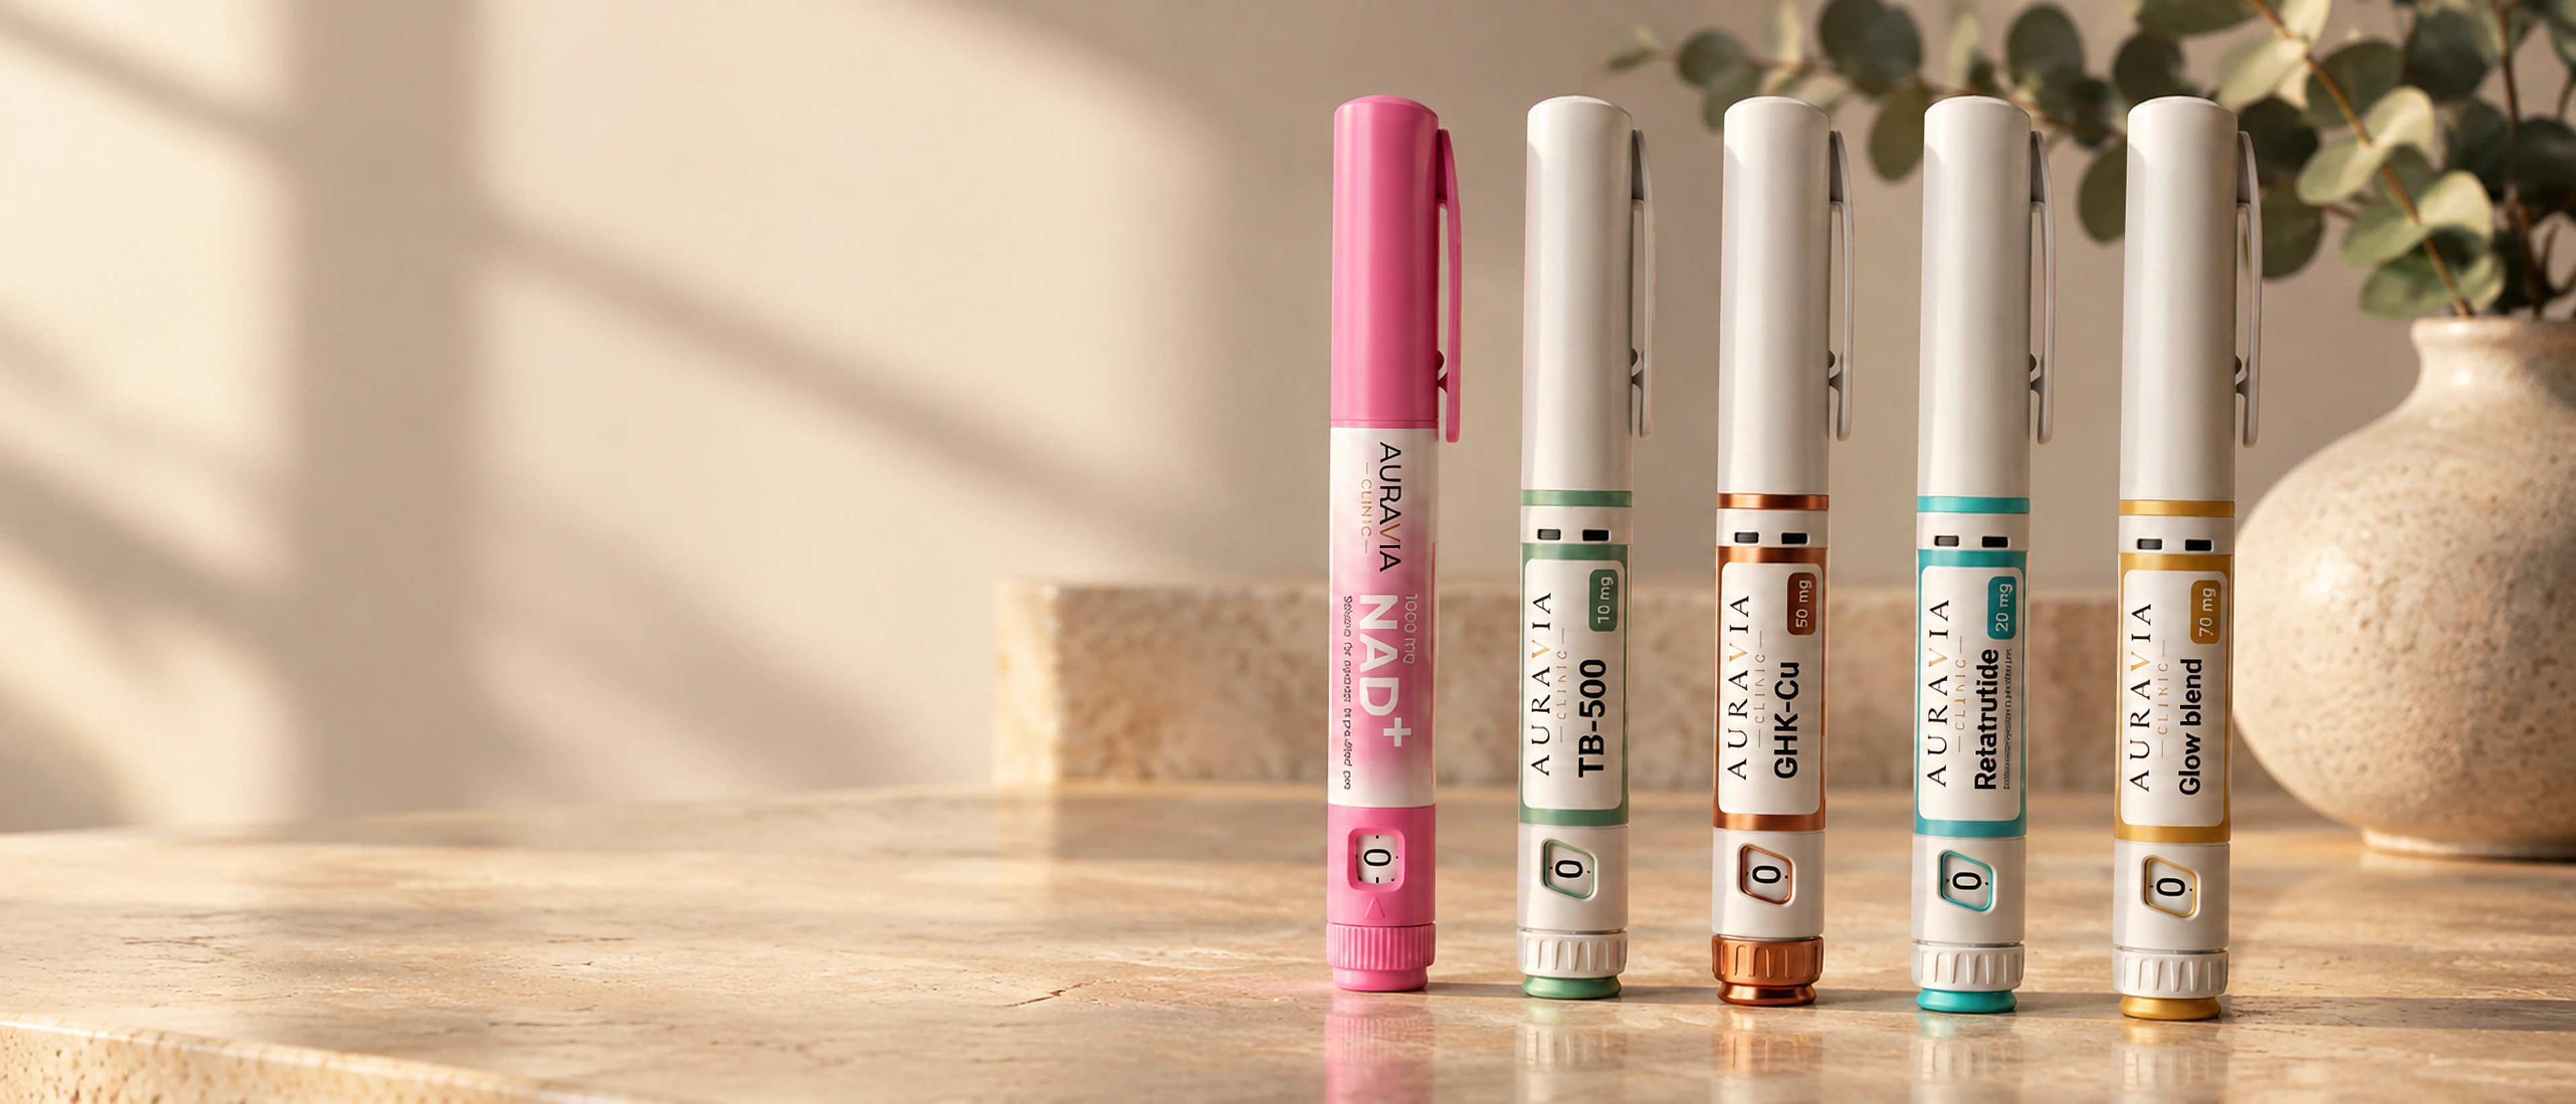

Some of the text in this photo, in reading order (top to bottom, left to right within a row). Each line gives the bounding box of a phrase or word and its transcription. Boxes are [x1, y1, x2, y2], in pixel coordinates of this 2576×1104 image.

[1361, 479, 1373, 537] CLINIC
[1379, 442, 1402, 572] AURAVIA
[1405, 594, 1418, 633] 1000
[1597, 576, 1613, 624] 10 mg
[1796, 580, 1812, 628] 50 mg
[1995, 613, 2009, 632] 20
[1999, 583, 2013, 608] mg
[2199, 587, 2216, 637] 70 mg
[1531, 592, 1552, 777] AURAVIA
[1727, 595, 1749, 781] AURAVIA
[1927, 600, 1949, 788] AURAVIA
[2129, 604, 2152, 792] AURAVIA
[2157, 662, 2169, 735] CLINIC
[1578, 660, 1607, 778] TB-500
[1773, 662, 1800, 779] GHK-Cu
[1974, 648, 1999, 790] Retatrutide
[2178, 658, 2202, 796] Glow blend
[1363, 849, 1392, 867] 0
[1555, 860, 1583, 878] 0
[1752, 865, 1781, 884] 0
[1952, 871, 1982, 890] 0
[2156, 877, 2185, 896] 0
